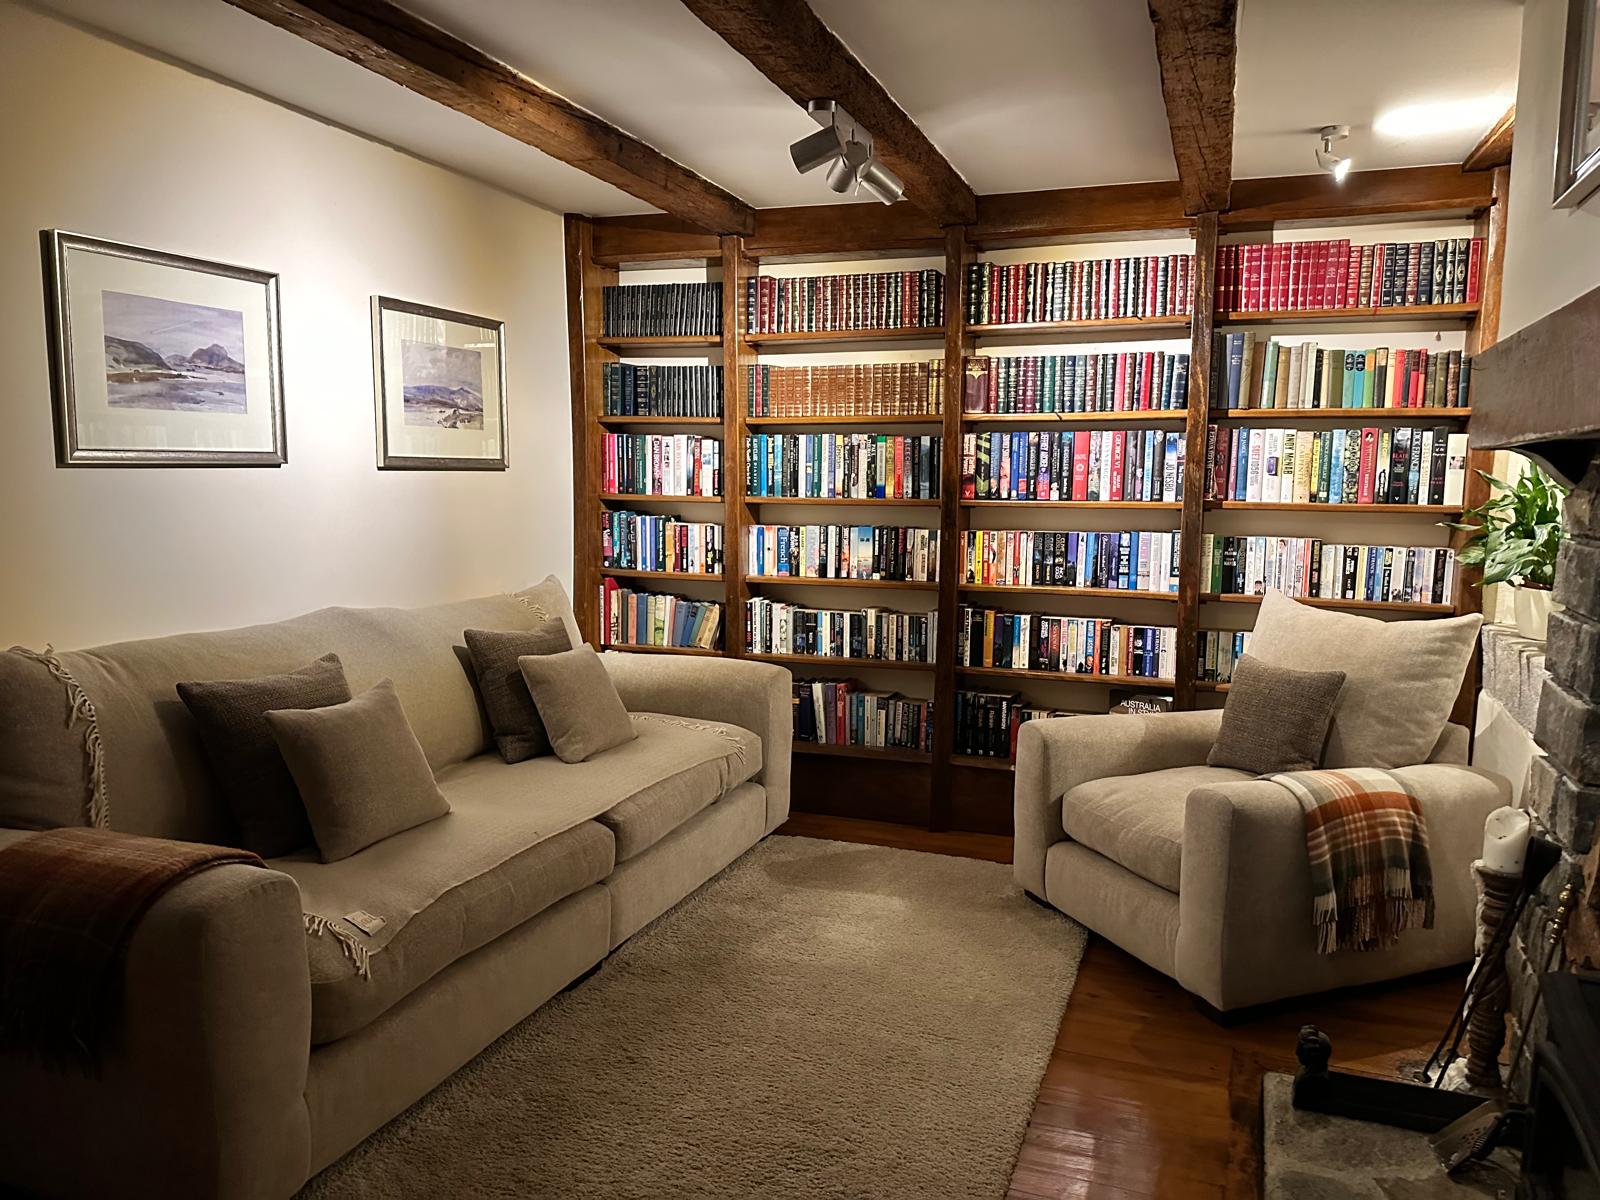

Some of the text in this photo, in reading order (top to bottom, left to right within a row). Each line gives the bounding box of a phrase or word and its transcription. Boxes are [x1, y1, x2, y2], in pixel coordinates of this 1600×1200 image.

[1283, 433, 1295, 475] ANDY McNAB
[1411, 431, 1421, 471] DICK FRANCIS
[1422, 442, 1430, 464] STEVE
[968, 456, 976, 474] Earthly
[1114, 461, 1121, 469] VI
[1166, 462, 1175, 470] JO
[1250, 461, 1259, 475] 1956
[780, 536, 788, 563] French
[1121, 700, 1161, 712] AUSTRALIA
[1128, 707, 1136, 715] IN
